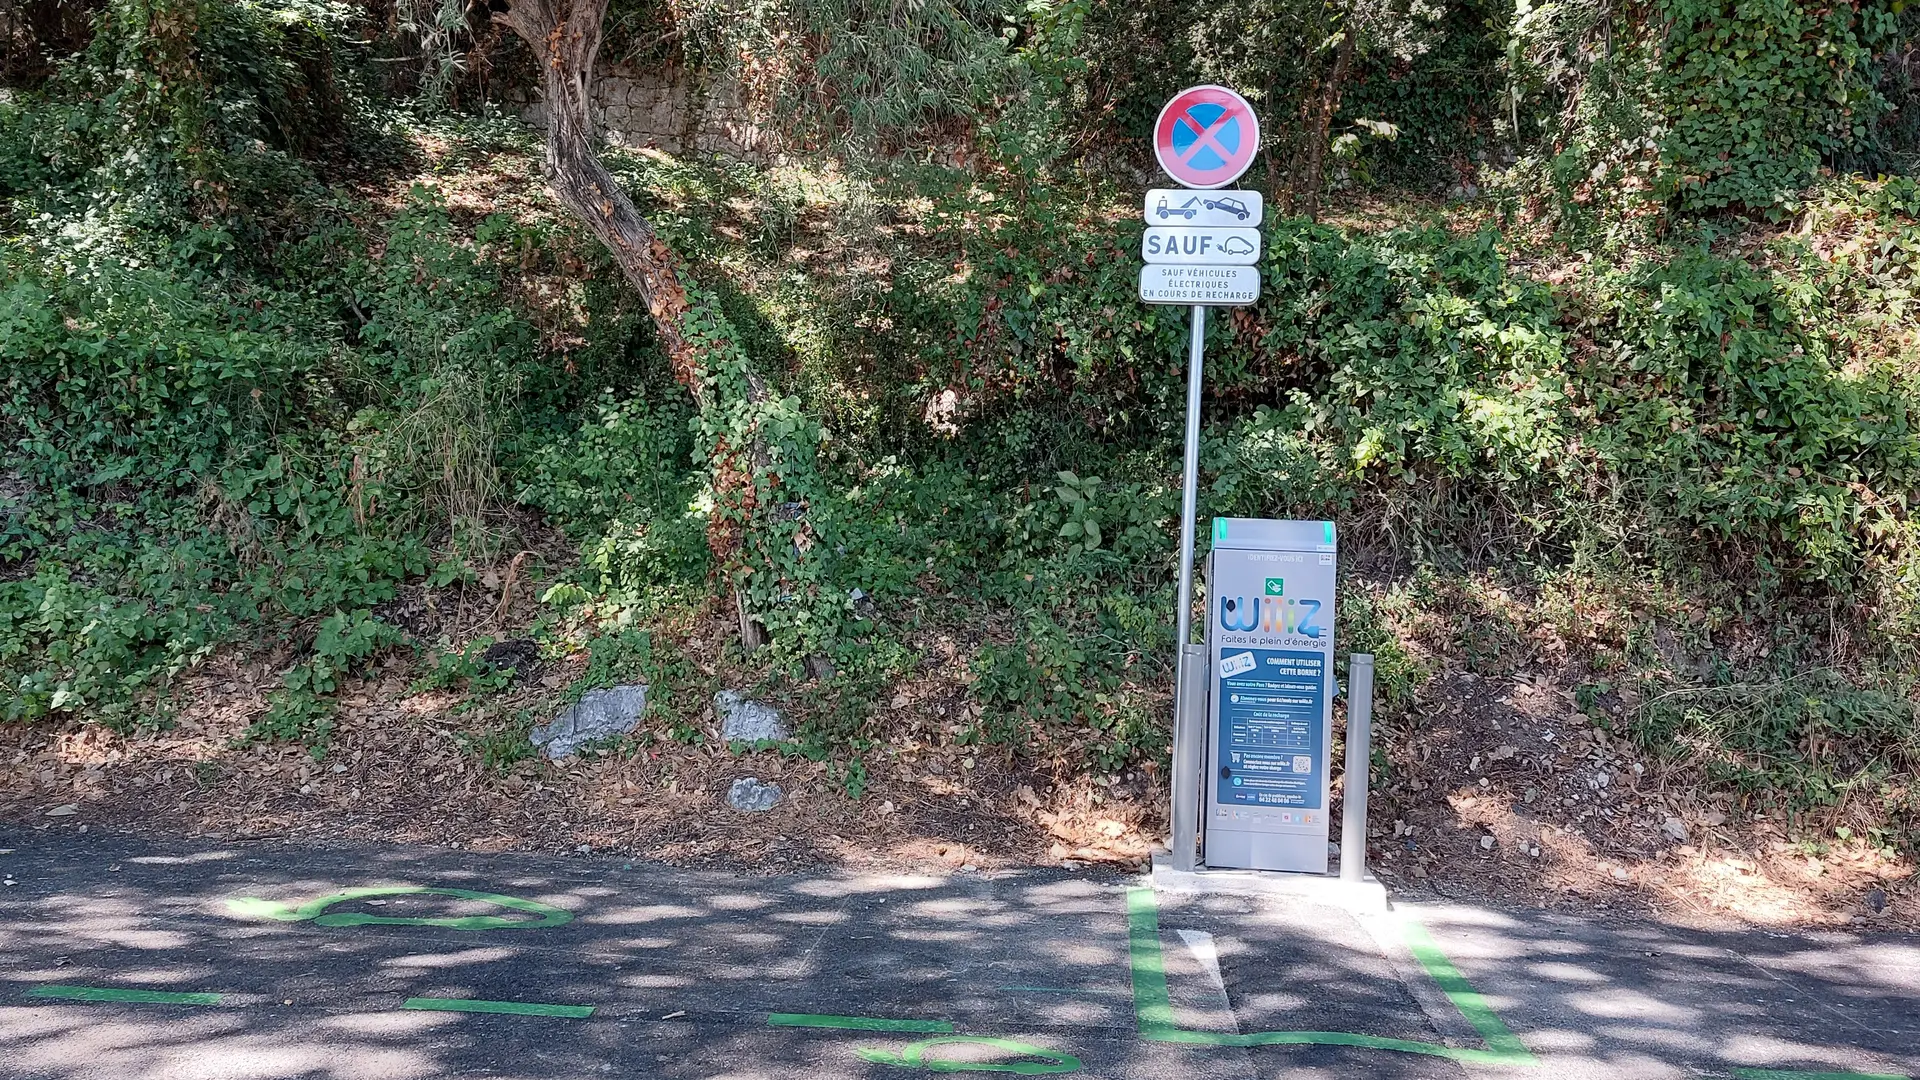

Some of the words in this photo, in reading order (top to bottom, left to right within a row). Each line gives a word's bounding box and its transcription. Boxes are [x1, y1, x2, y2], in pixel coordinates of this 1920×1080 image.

[1148, 235, 1212, 255] SAUF
[1162, 269, 1184, 277] SAUF
[1187, 268, 1237, 278] VÉHICULES
[1168, 279, 1229, 289] ÉLECTRIQUES
[1158, 290, 1187, 298] COURS
[1206, 291, 1253, 300] RECHARGE
[1221, 635, 1246, 644] Faites
[1249, 636, 1257, 644] le
[1260, 636, 1282, 646] plein
[1284, 637, 1326, 648] d'énergie
[1267, 658, 1295, 666] COMMENT
